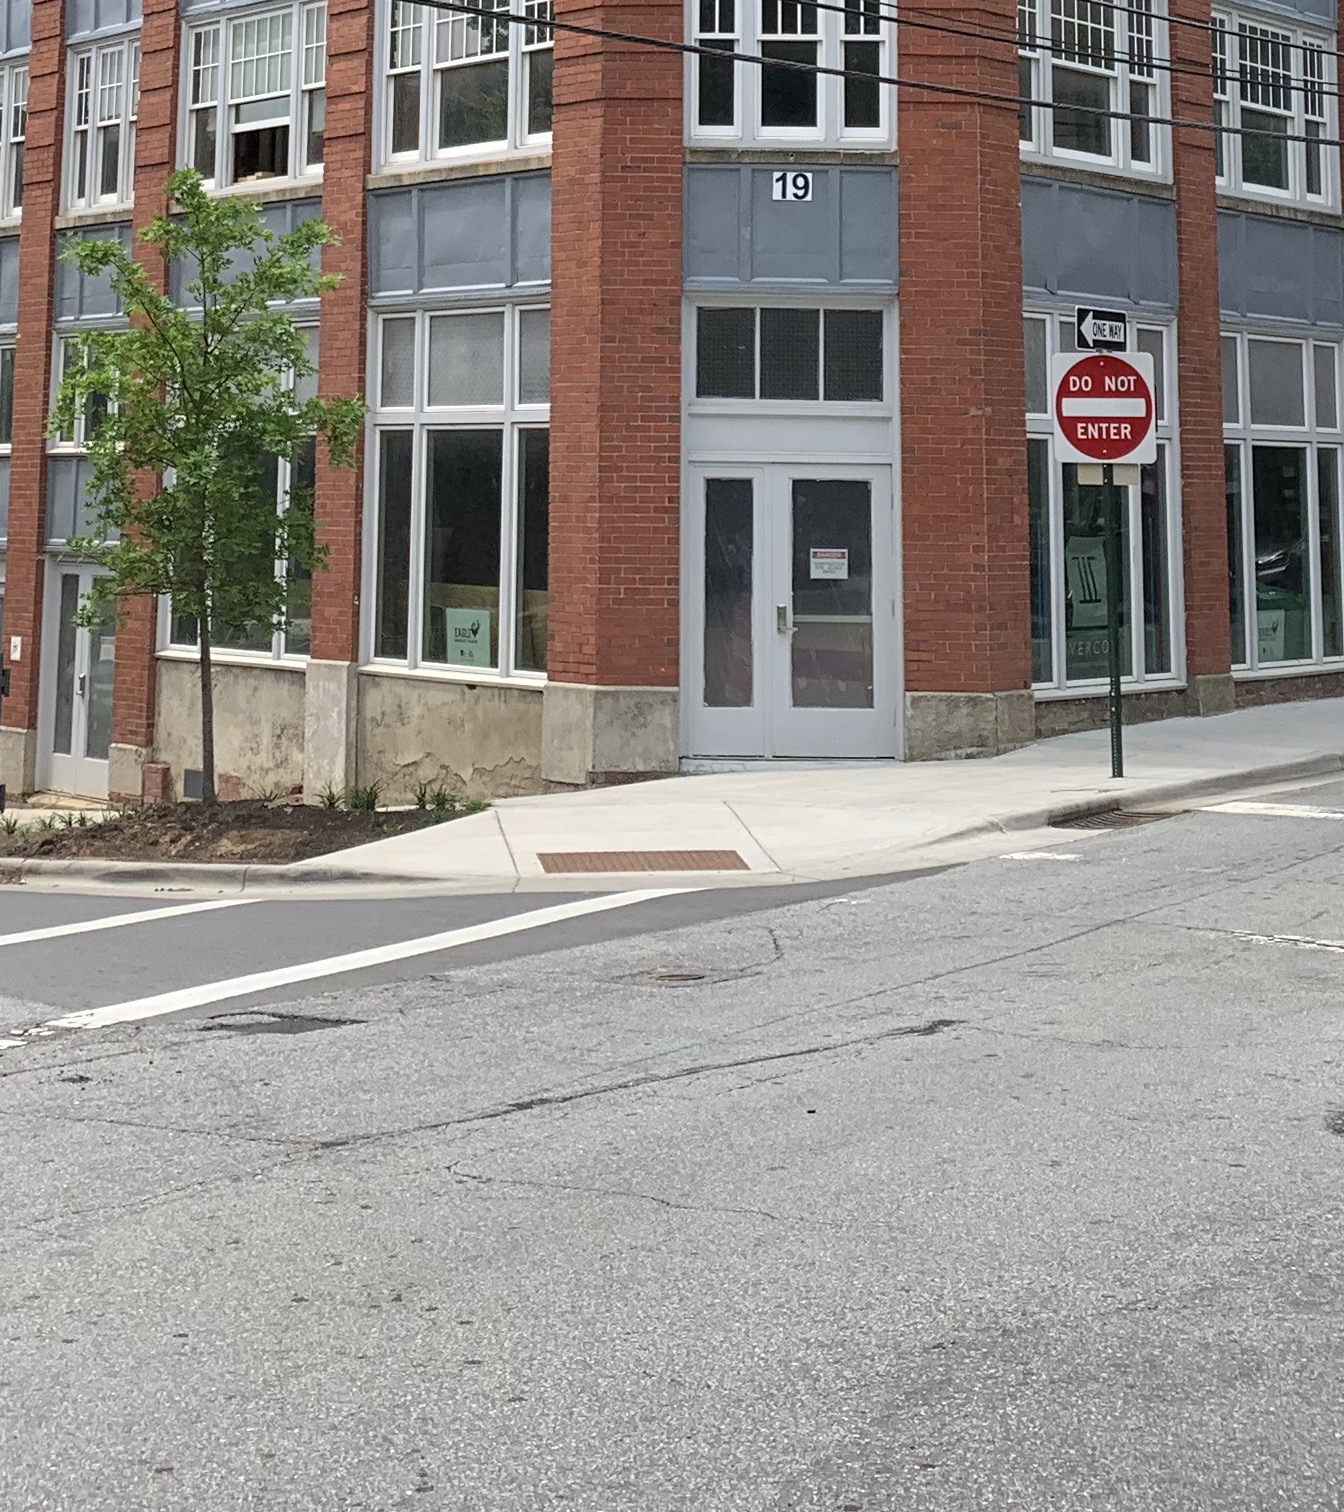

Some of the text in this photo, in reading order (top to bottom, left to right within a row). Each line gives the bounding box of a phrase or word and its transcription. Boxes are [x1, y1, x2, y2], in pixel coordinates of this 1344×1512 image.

[775, 172, 810, 200] 19
[1092, 322, 1123, 339] ONE WAY
[1069, 376, 1137, 392] DO NOT
[1076, 423, 1132, 440] ENTER
